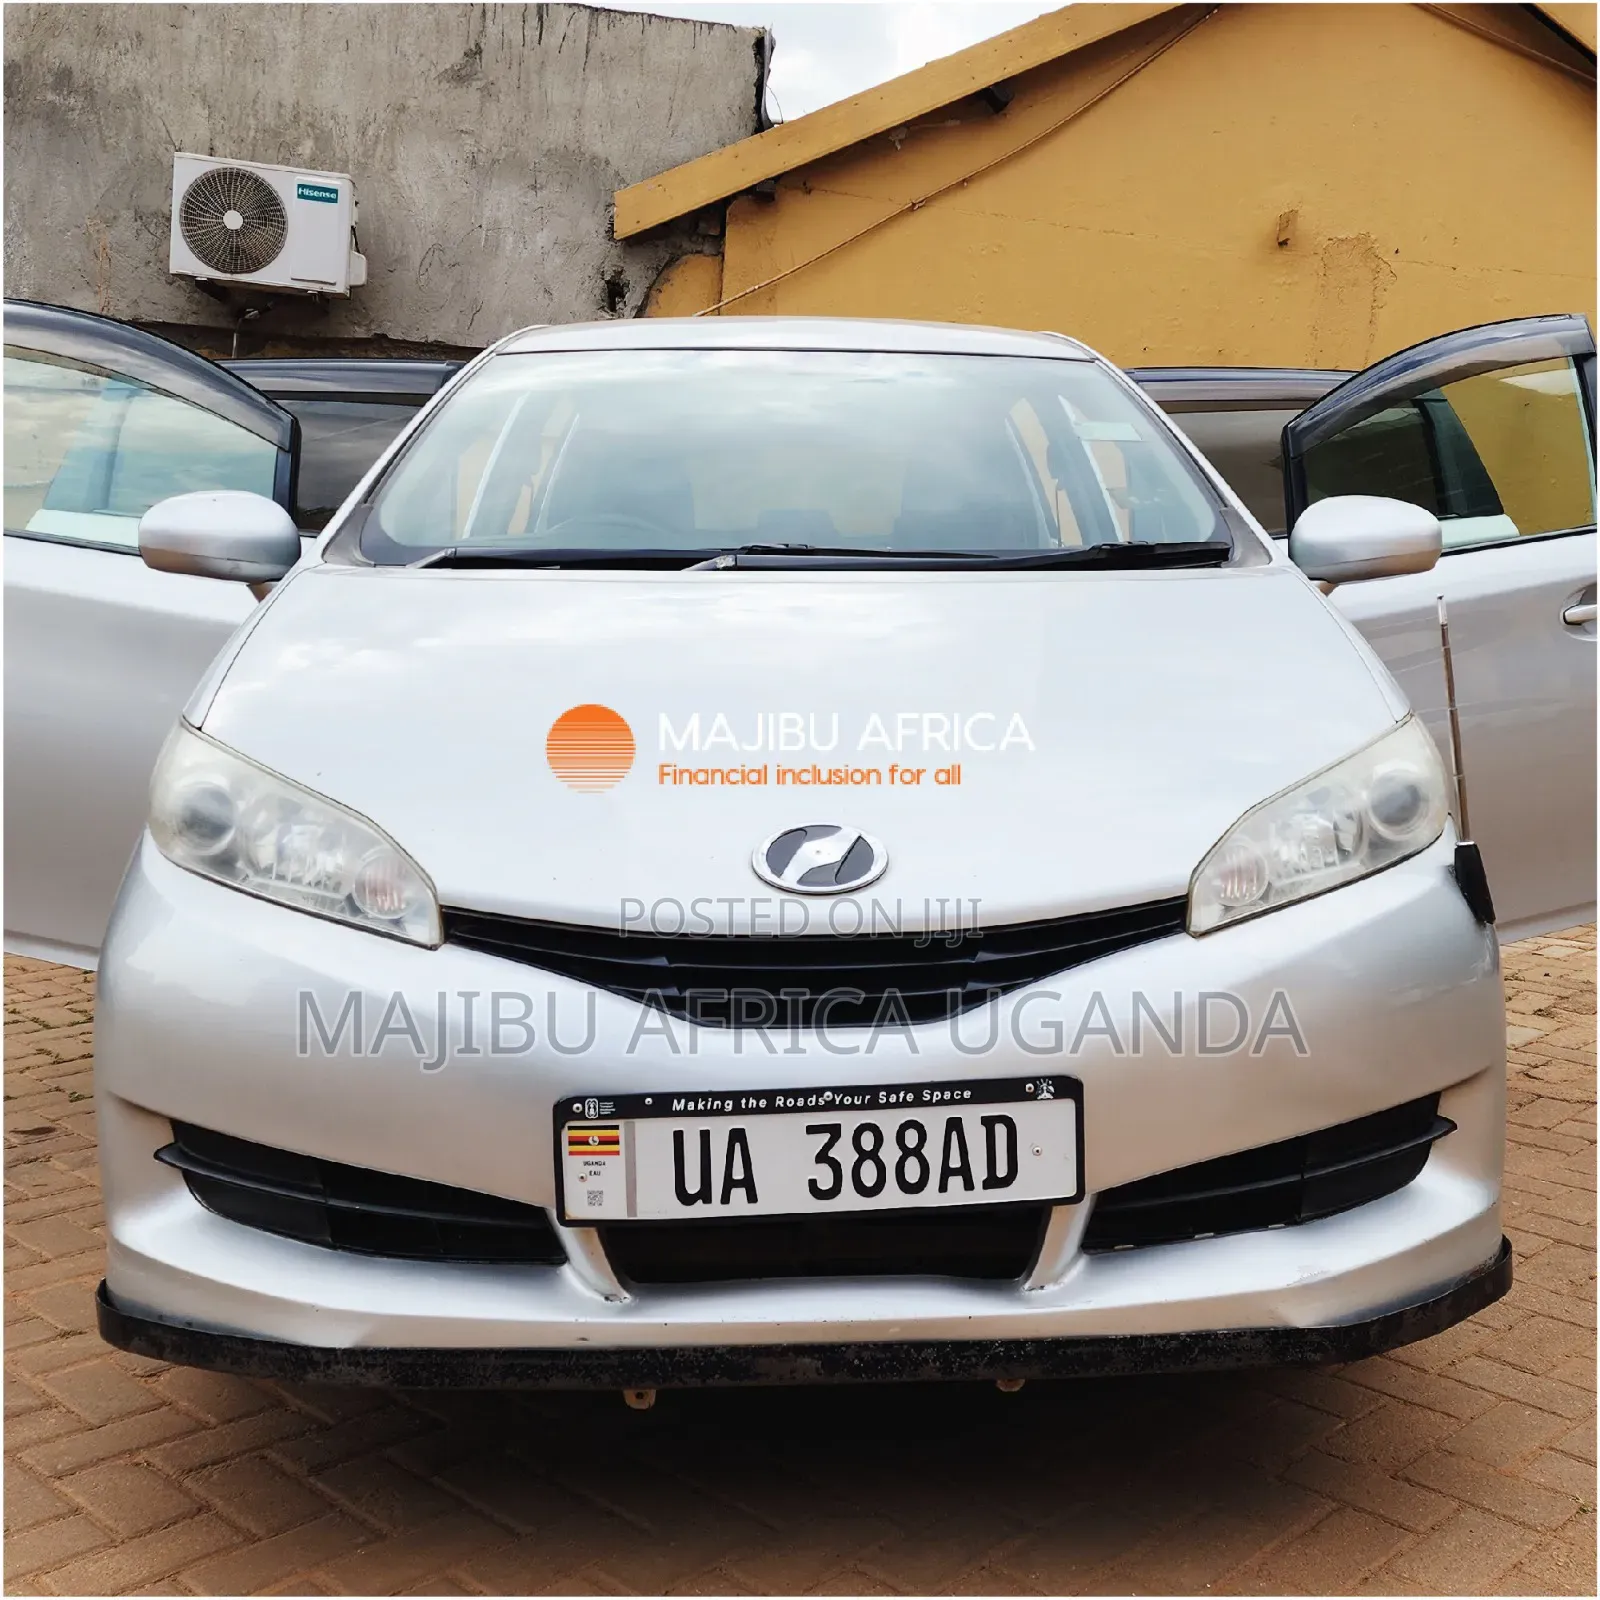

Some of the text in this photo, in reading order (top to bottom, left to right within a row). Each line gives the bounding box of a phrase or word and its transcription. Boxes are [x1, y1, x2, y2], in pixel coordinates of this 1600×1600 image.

[299, 187, 337, 199] Hisense
[672, 1088, 973, 1112] Making the Roads Your Safe Space
[673, 1115, 1019, 1205] UA 388AD
